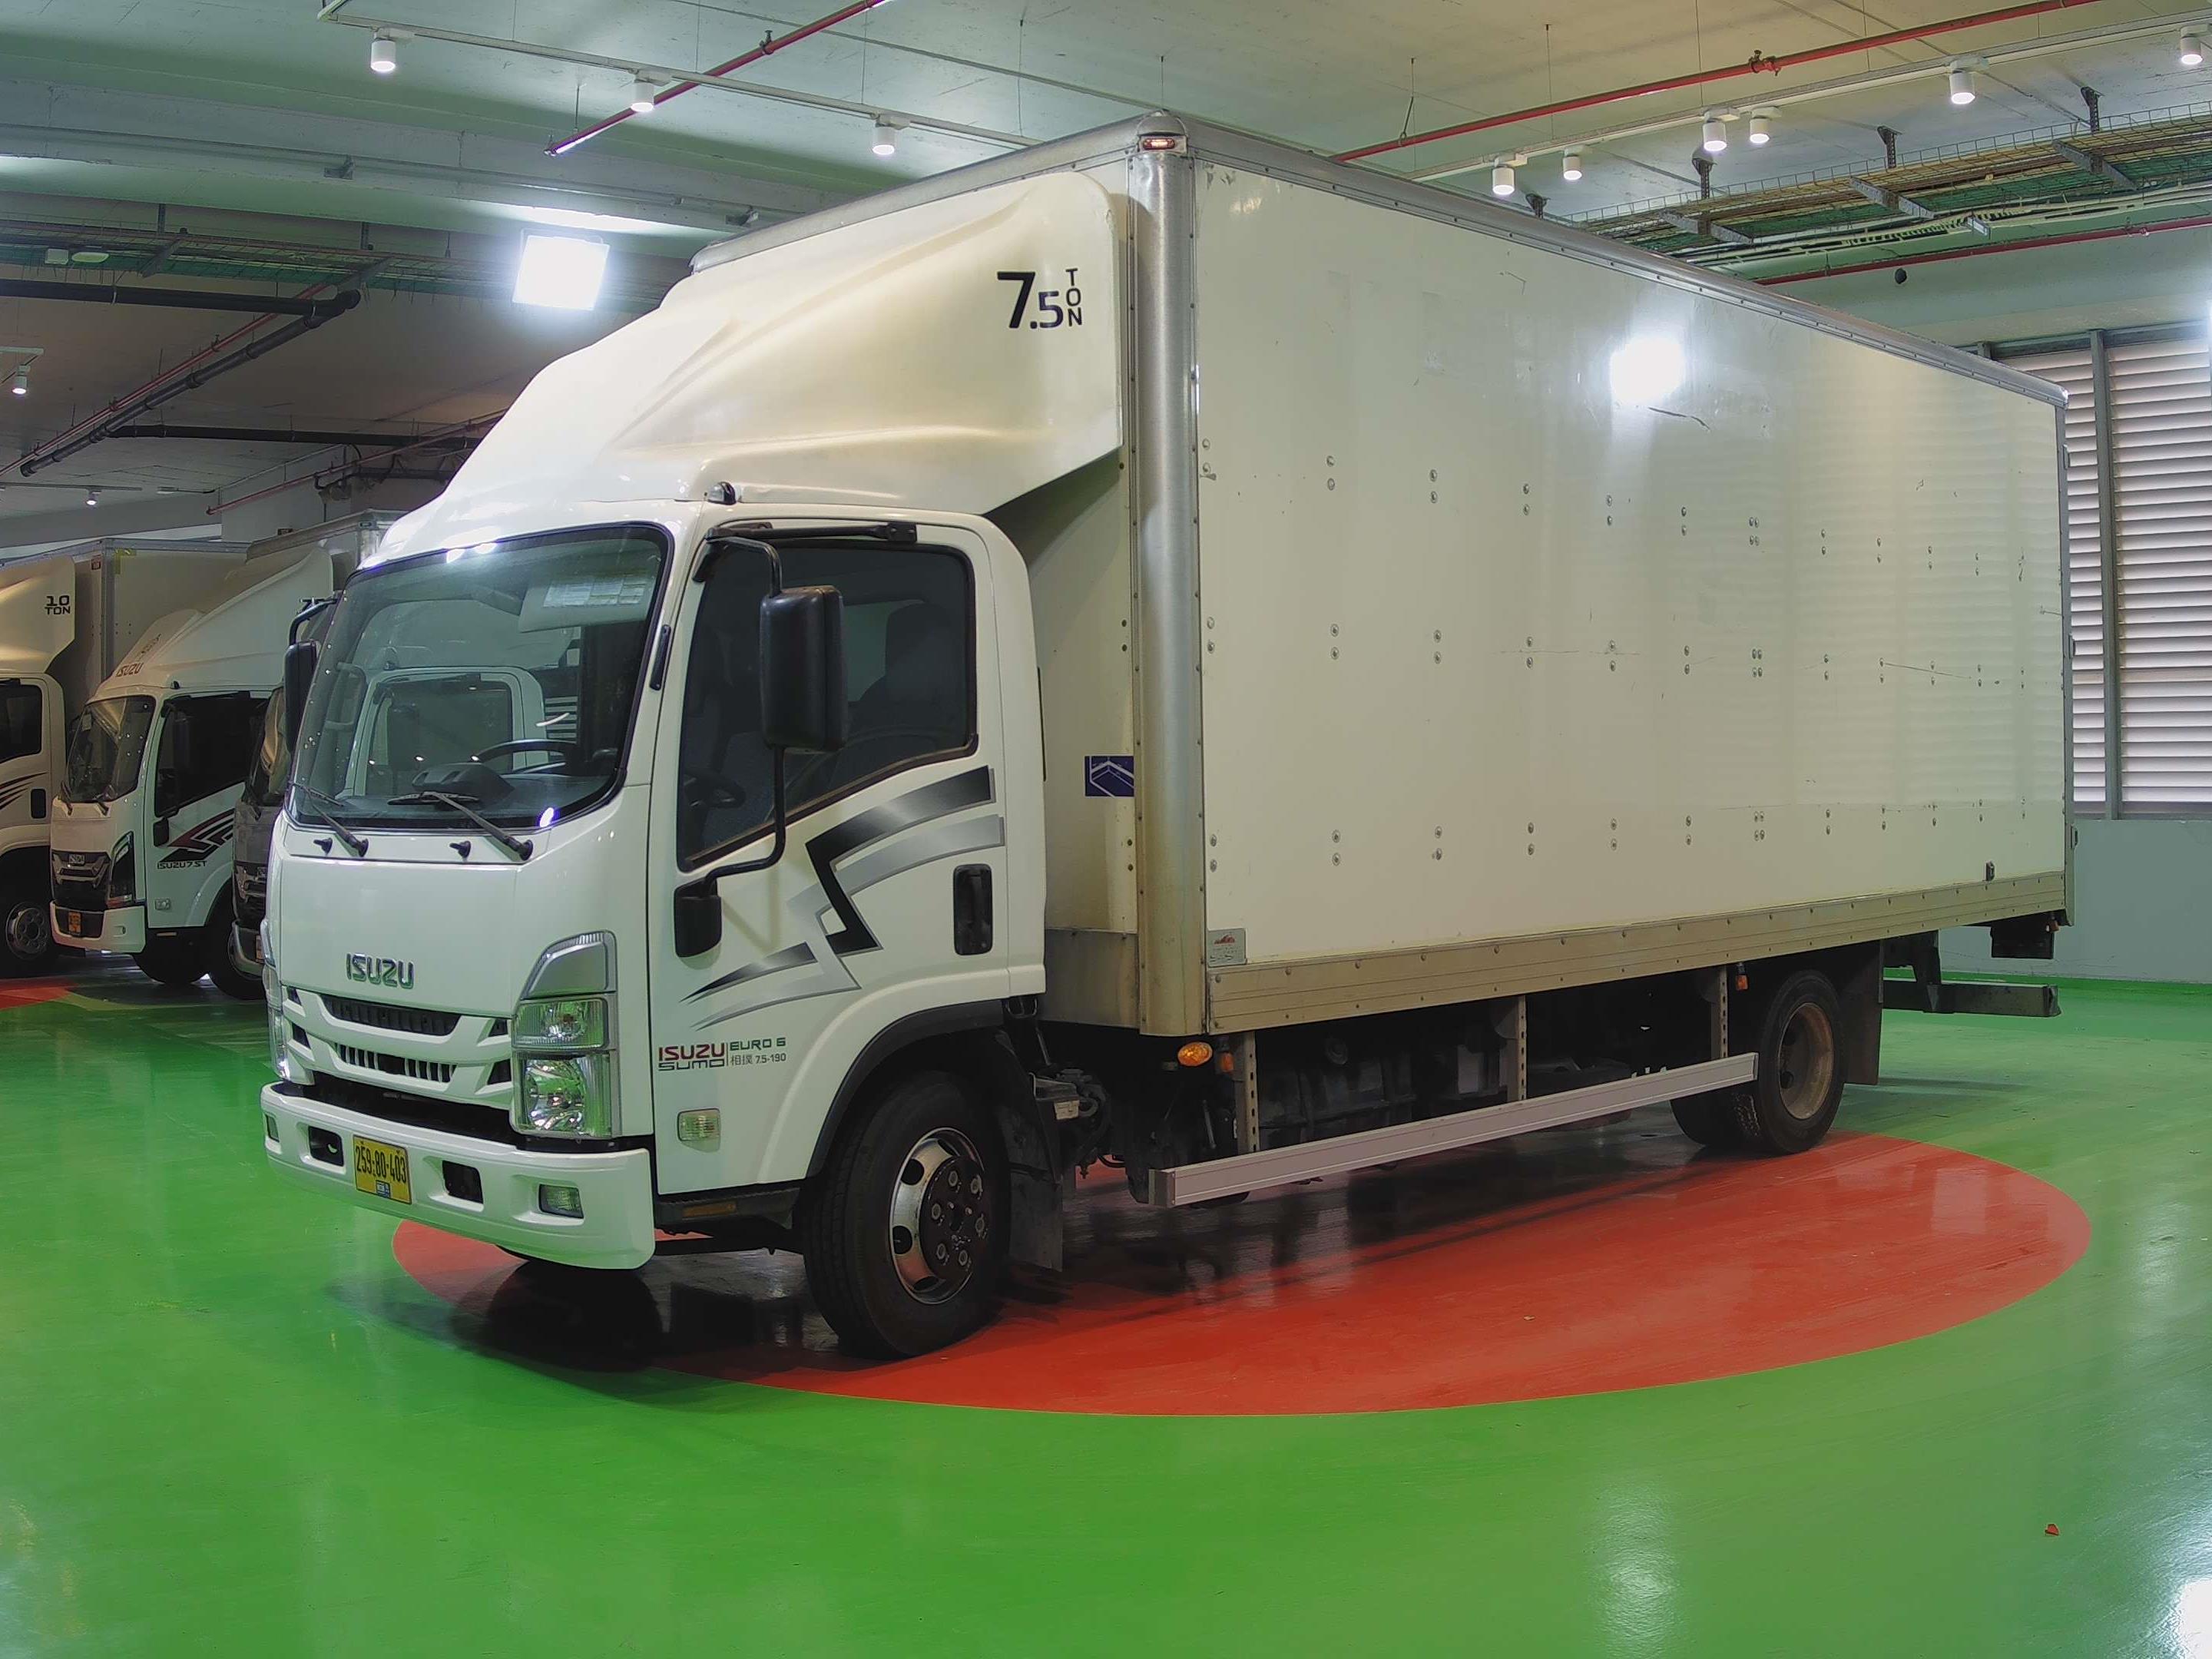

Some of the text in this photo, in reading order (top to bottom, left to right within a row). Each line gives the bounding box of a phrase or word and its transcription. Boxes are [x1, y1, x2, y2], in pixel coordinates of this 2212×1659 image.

[997, 268, 1082, 329] 7.5 TON
[46, 595, 70, 606] 10
[45, 606, 71, 615] TON
[346, 953, 414, 989] ISUZU
[730, 1037, 786, 1051] EURO 6
[658, 1043, 725, 1061] ISUZU
[658, 1059, 725, 1071] SUMO
